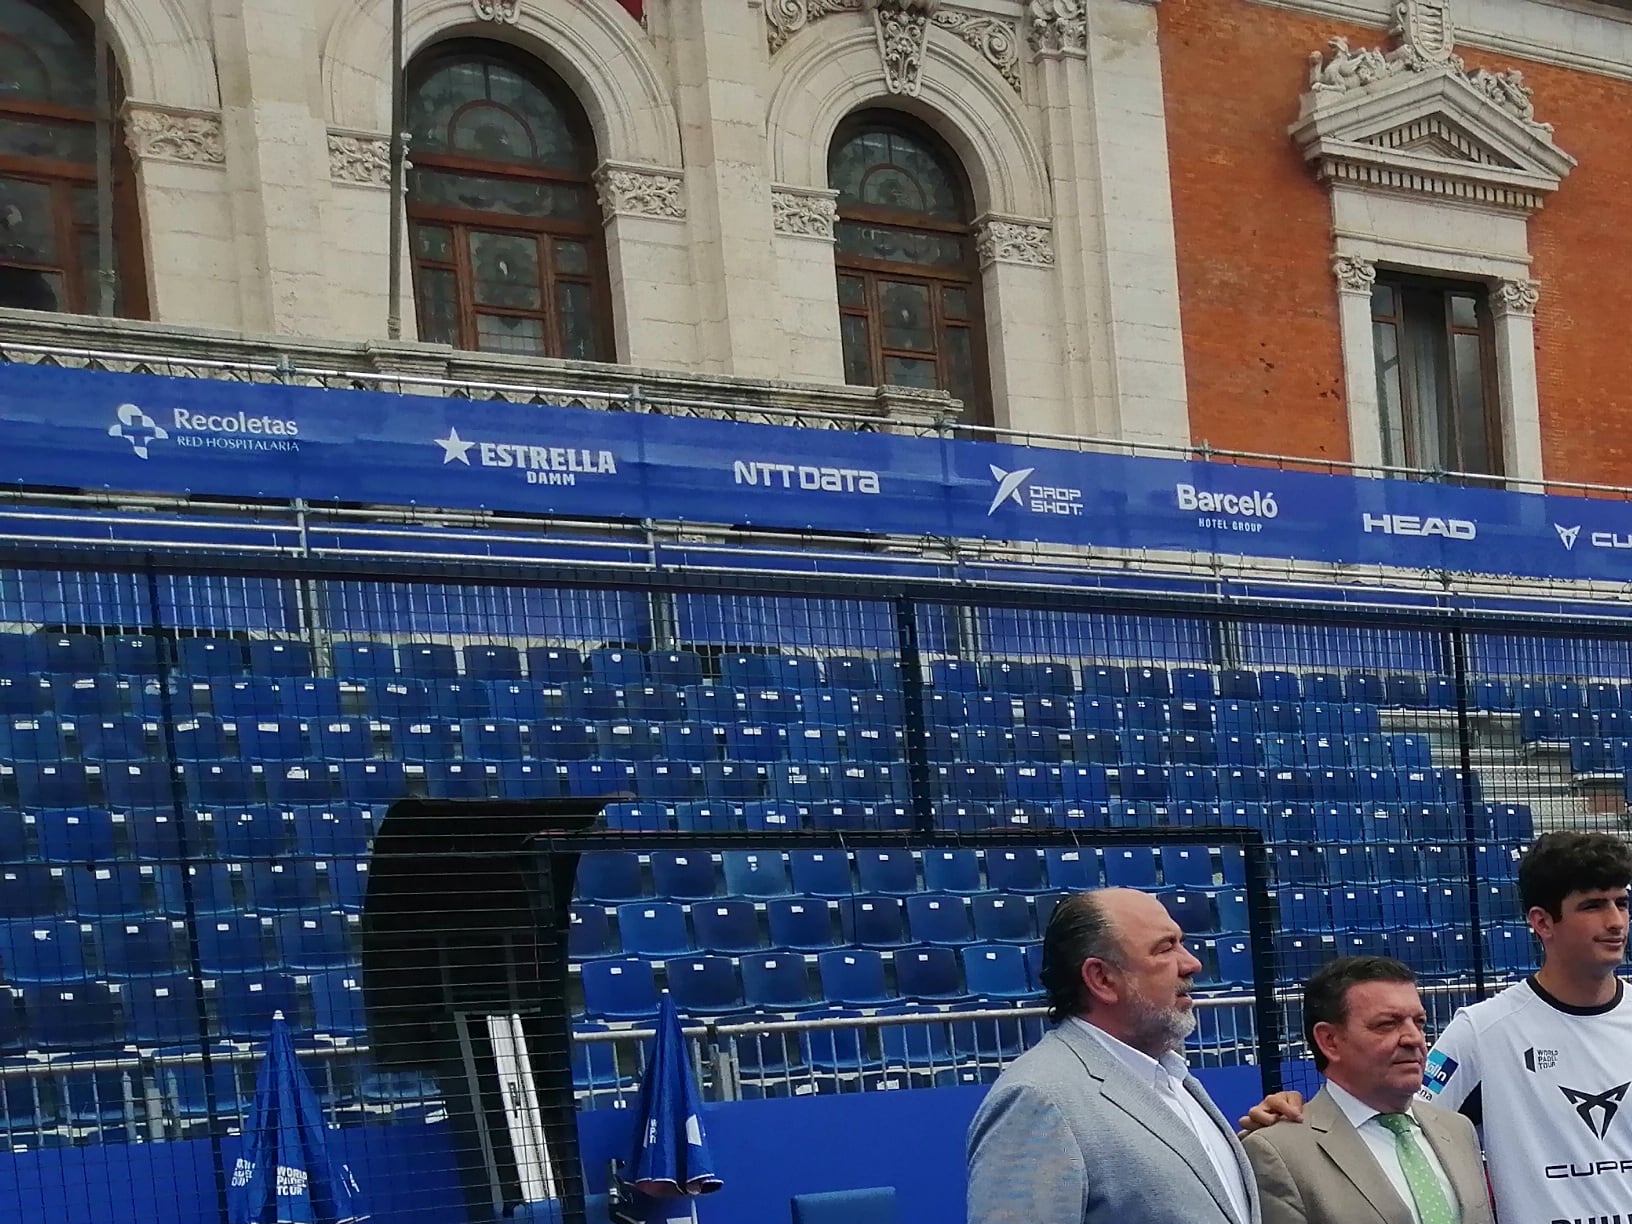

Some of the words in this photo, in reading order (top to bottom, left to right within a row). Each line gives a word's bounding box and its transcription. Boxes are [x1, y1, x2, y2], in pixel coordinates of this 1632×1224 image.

[173, 408, 299, 436] Recoletas
[177, 435, 203, 447] RED
[206, 437, 300, 452] HOSPITALARIA
[480, 443, 617, 475] ESTRELLA
[527, 471, 576, 486] DAMM
[734, 461, 797, 488] NTT
[1029, 485, 1082, 499] DROP
[1031, 501, 1084, 516] SHOT
[1176, 483, 1279, 518] Barceló
[1198, 517, 1229, 530] HOTEL
[1232, 520, 1263, 533] GROUP
[1363, 513, 1476, 540] HEAD
[277, 1165, 308, 1180] WORLD
[276, 1185, 303, 1196] TOUR
